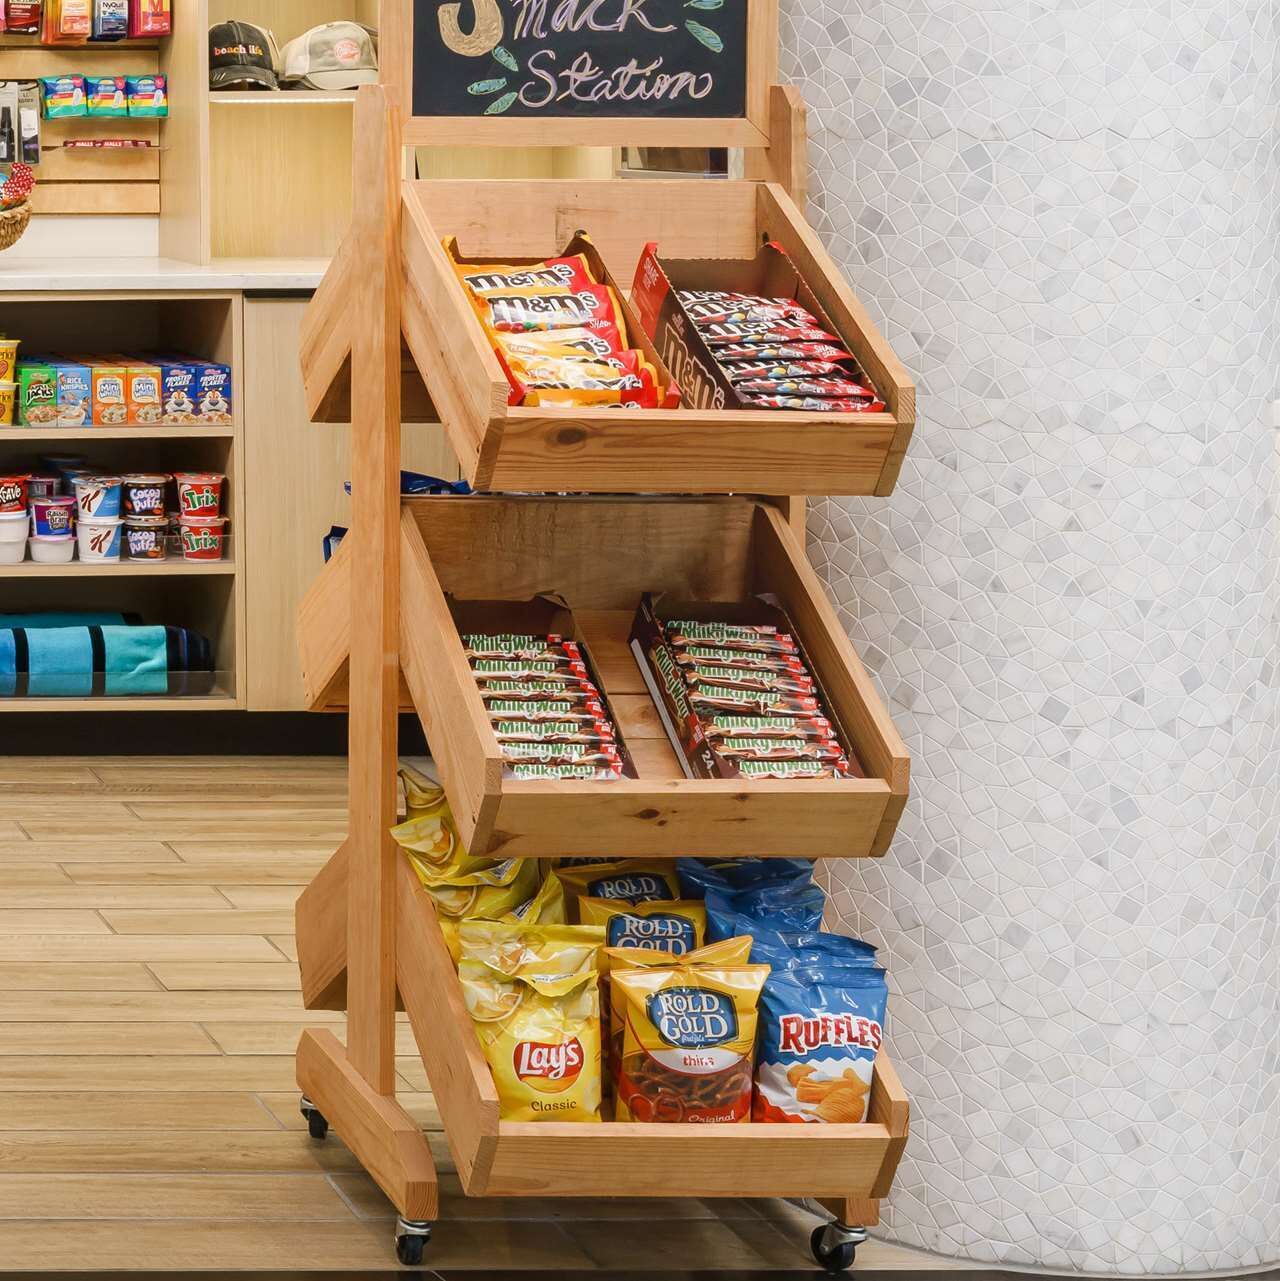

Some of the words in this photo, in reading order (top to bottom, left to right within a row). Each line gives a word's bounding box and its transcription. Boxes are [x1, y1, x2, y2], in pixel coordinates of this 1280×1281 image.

[102, 1, 124, 10] NyQuil
[214, 44, 247, 57] beach
[517, 49, 713, 108] Station
[166, 374, 192, 383] FROSTED
[200, 373, 227, 382] FROSTED
[26, 387, 54, 406] JACKS
[100, 383, 119, 392] Mini
[135, 383, 154, 392] Mini
[81, 489, 102, 513] K
[130, 488, 161, 499] Cocoa
[185, 488, 218, 510] Trix
[133, 497, 162, 513] Puffs
[90, 529, 112, 554] K
[127, 530, 156, 541] Cocoa
[184, 530, 218, 552] Trix
[130, 539, 156, 556] Puffs
[603, 877, 657, 897] ROLD
[623, 916, 683, 937] ROLD
[617, 935, 687, 955] GOLD
[658, 993, 720, 1015] ROLD
[661, 1014, 728, 1040] GOLD
[780, 1013, 882, 1054] RUFFLES
[519, 1040, 580, 1080] Lay's
[531, 1099, 577, 1112] Classic
[688, 1108, 736, 1122] Original
